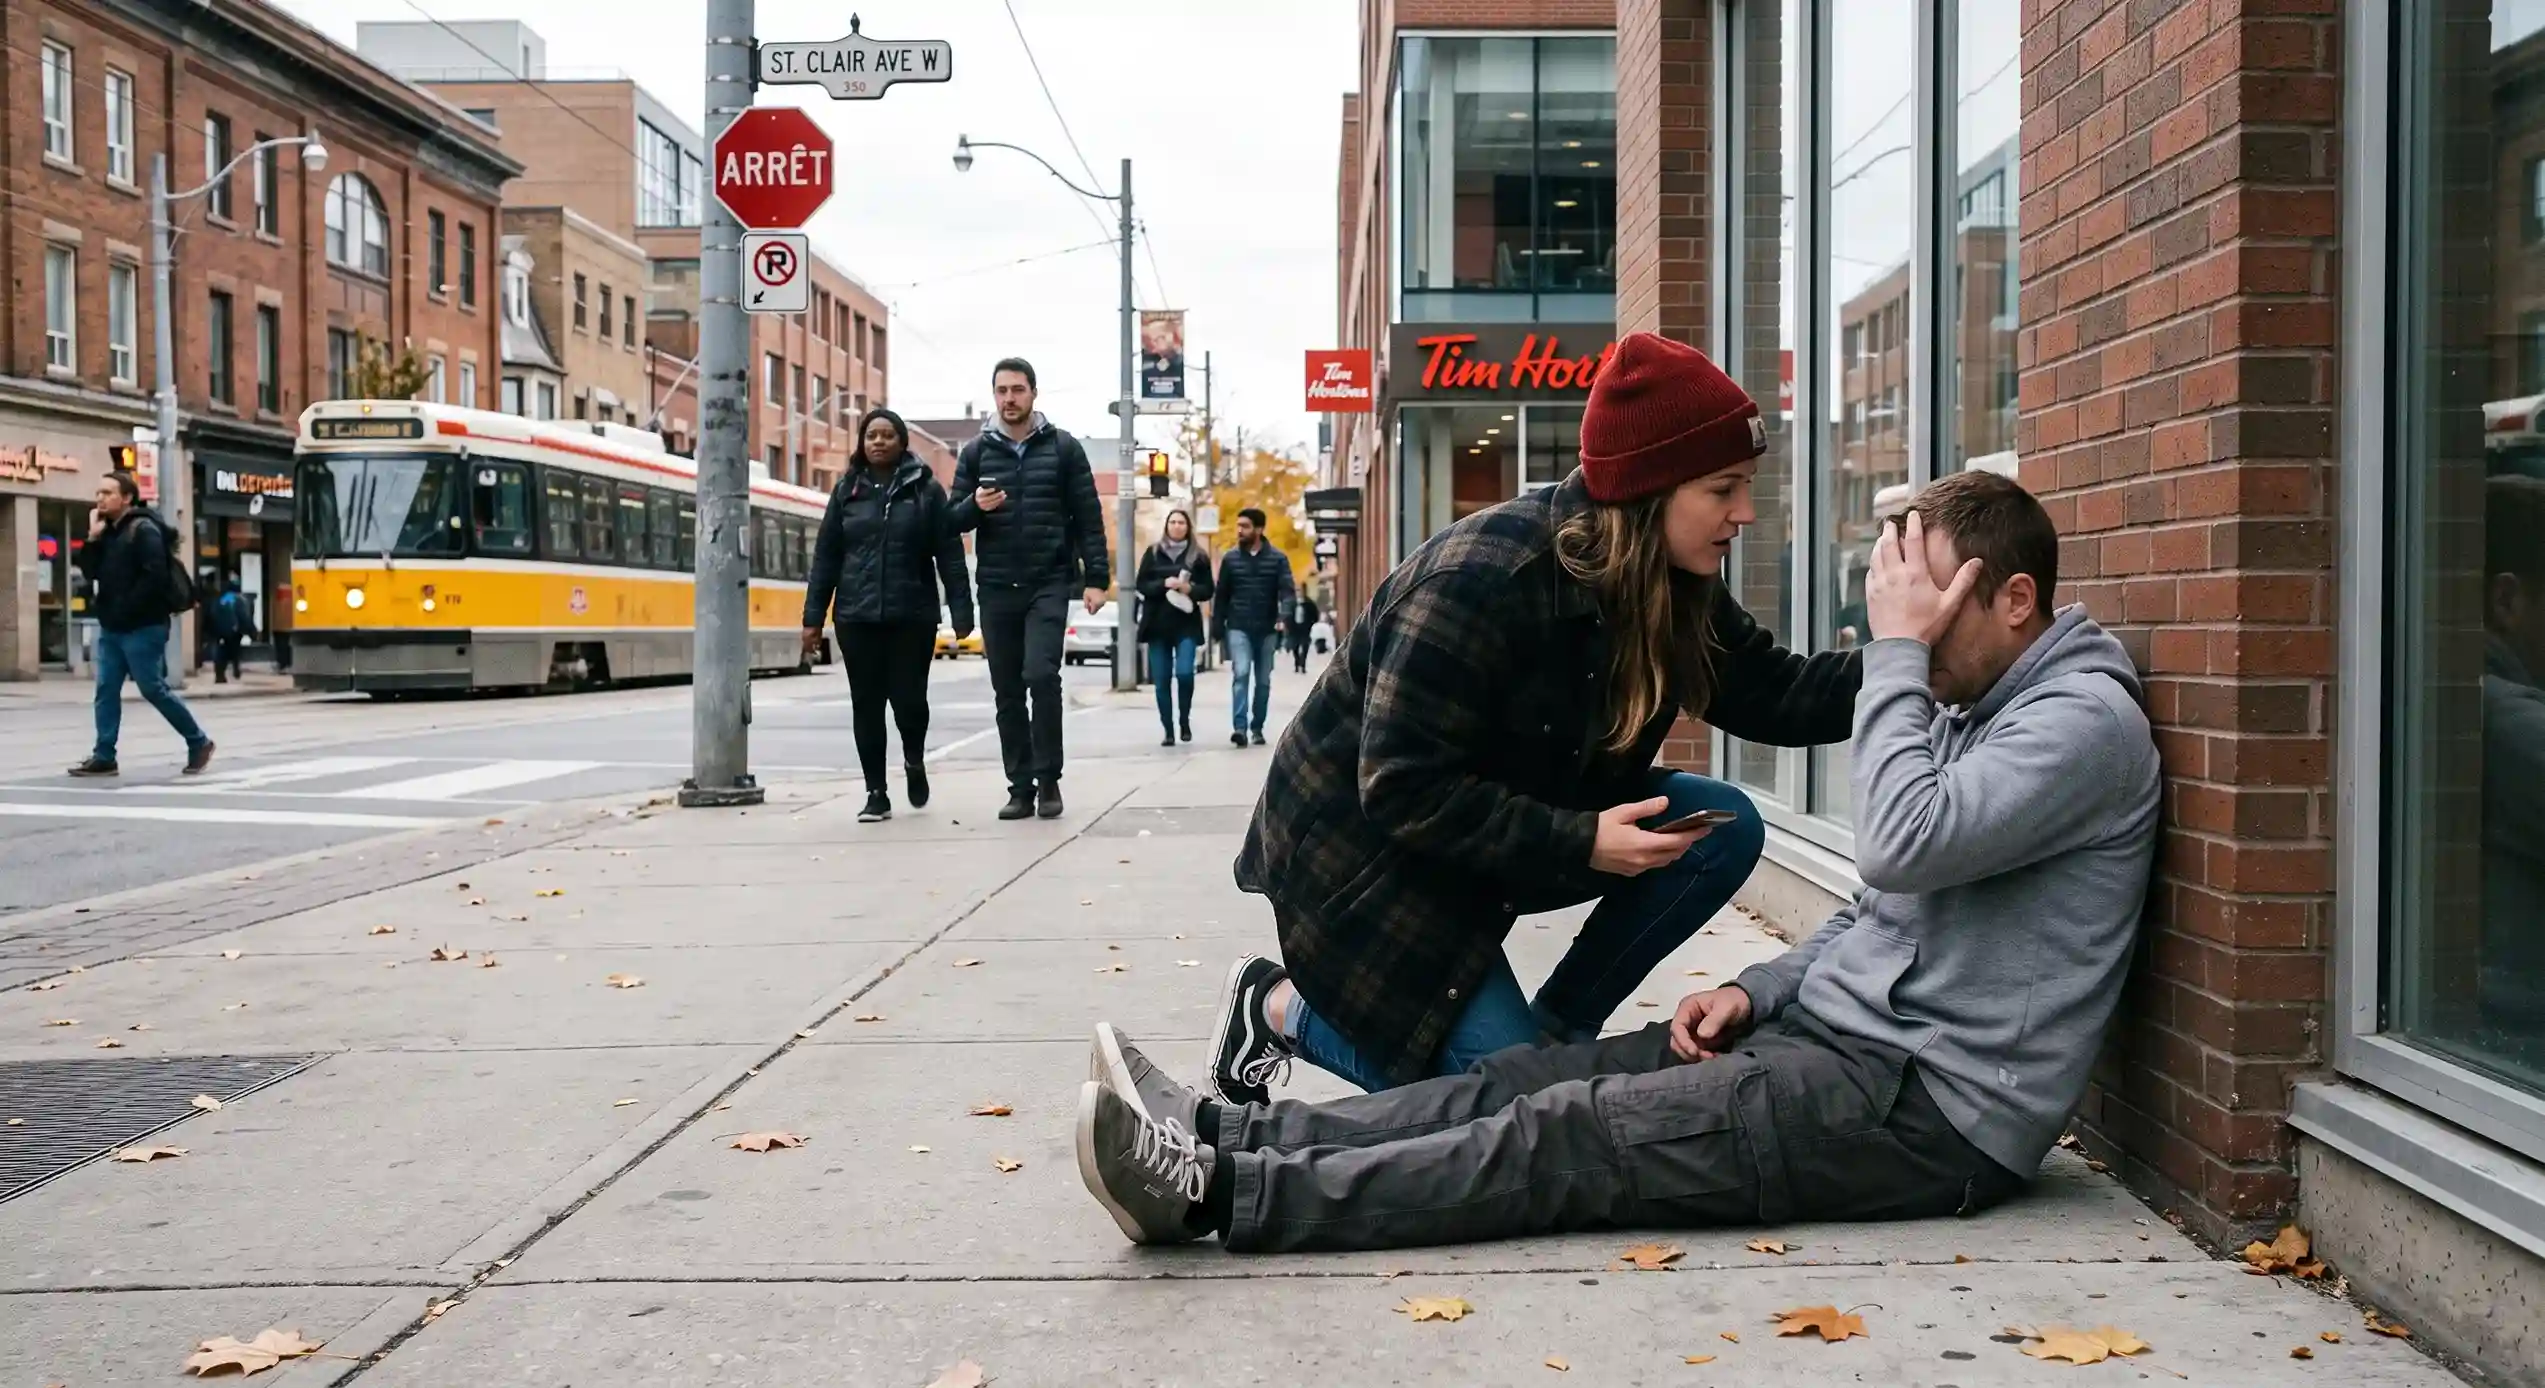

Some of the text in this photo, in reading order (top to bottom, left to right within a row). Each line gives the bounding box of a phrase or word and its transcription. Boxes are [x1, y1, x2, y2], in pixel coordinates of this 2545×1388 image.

[770, 49, 938, 74] ST. CLAIR AVE W
[843, 81, 867, 93] 350
[720, 143, 828, 186] ARRÊT
[1416, 333, 1502, 389] Tim
